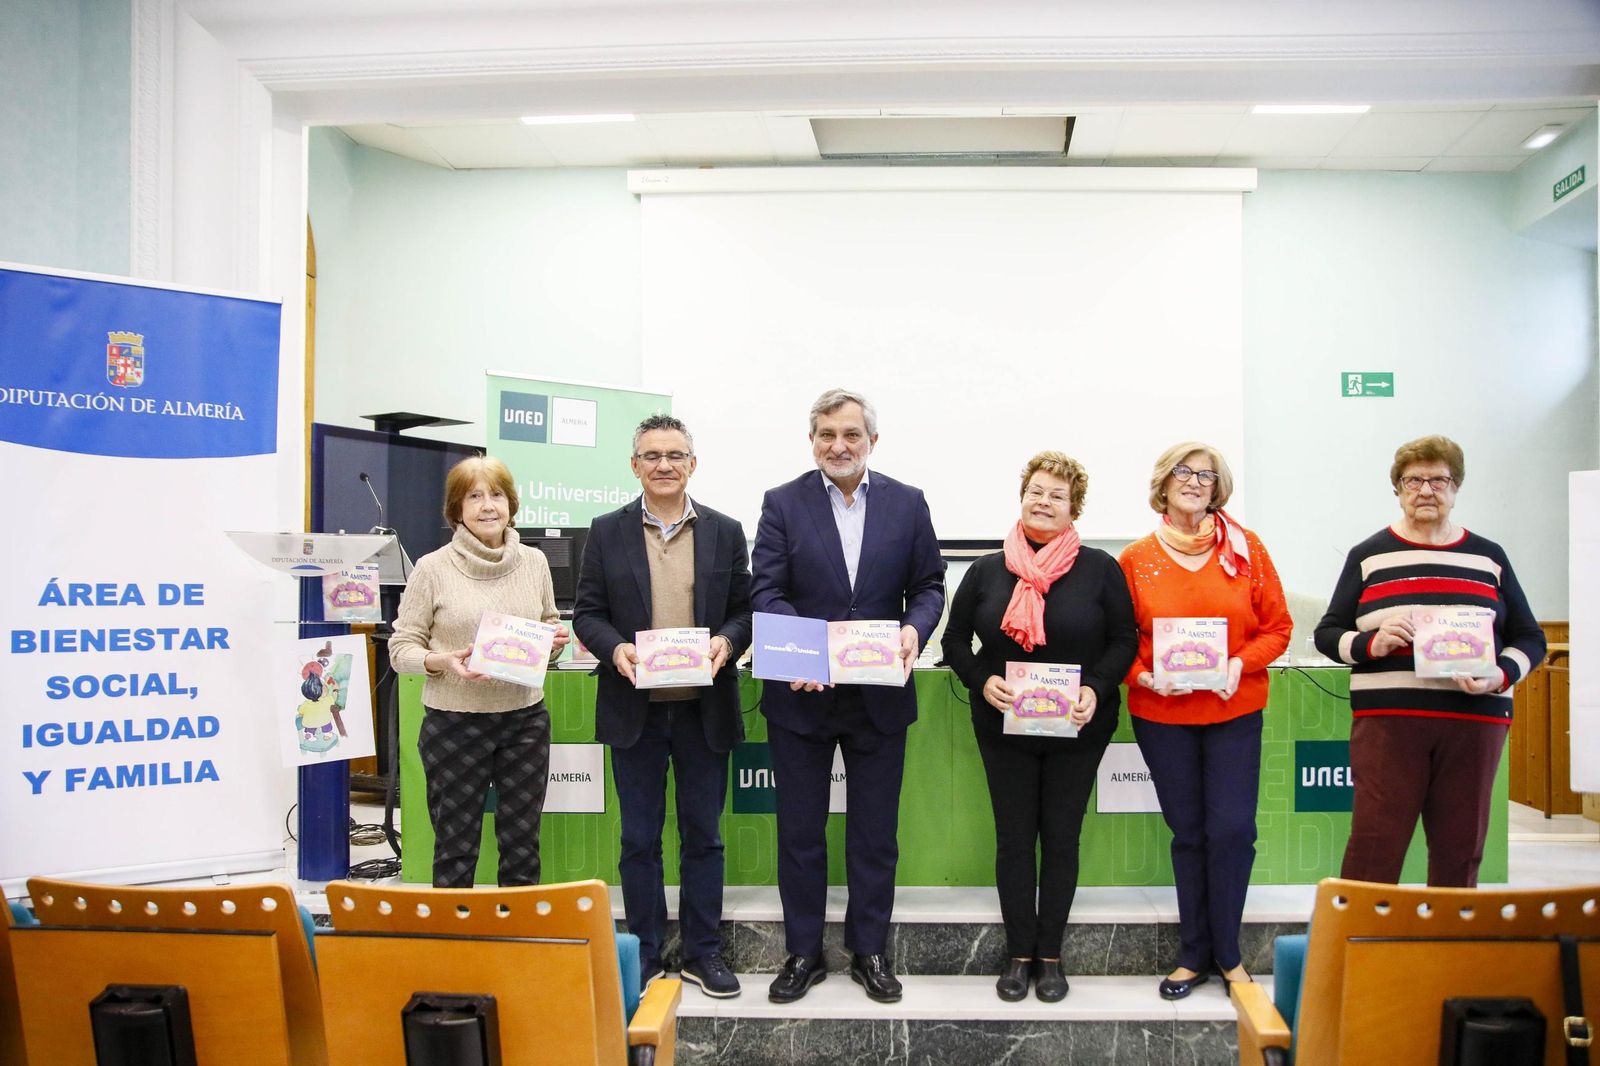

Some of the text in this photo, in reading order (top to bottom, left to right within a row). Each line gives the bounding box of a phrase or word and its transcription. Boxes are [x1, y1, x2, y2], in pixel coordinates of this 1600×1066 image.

[1555, 169, 1584, 197] SALIDA
[0, 387, 246, 421] DIPUTACIÓN DE ALMERÍA
[504, 408, 544, 426] UNED
[349, 573, 373, 581] AMISTAD
[38, 577, 205, 607] ÁREA DE
[504, 623, 514, 632] LA
[514, 629, 544, 641] AMISTAD
[851, 627, 892, 639] LA AMISTAD
[1177, 626, 1217, 639] LA AMISTAD
[1449, 620, 1481, 629] AMISTAD
[10, 627, 230, 654] BIENESTAR
[671, 637, 700, 645] AMISTAD
[46, 672, 198, 700] SOCIAL,
[1030, 672, 1070, 686] LA AMISTAD
[22, 715, 220, 749] IGUALDAD
[23, 759, 220, 795] Y FAMILIA
